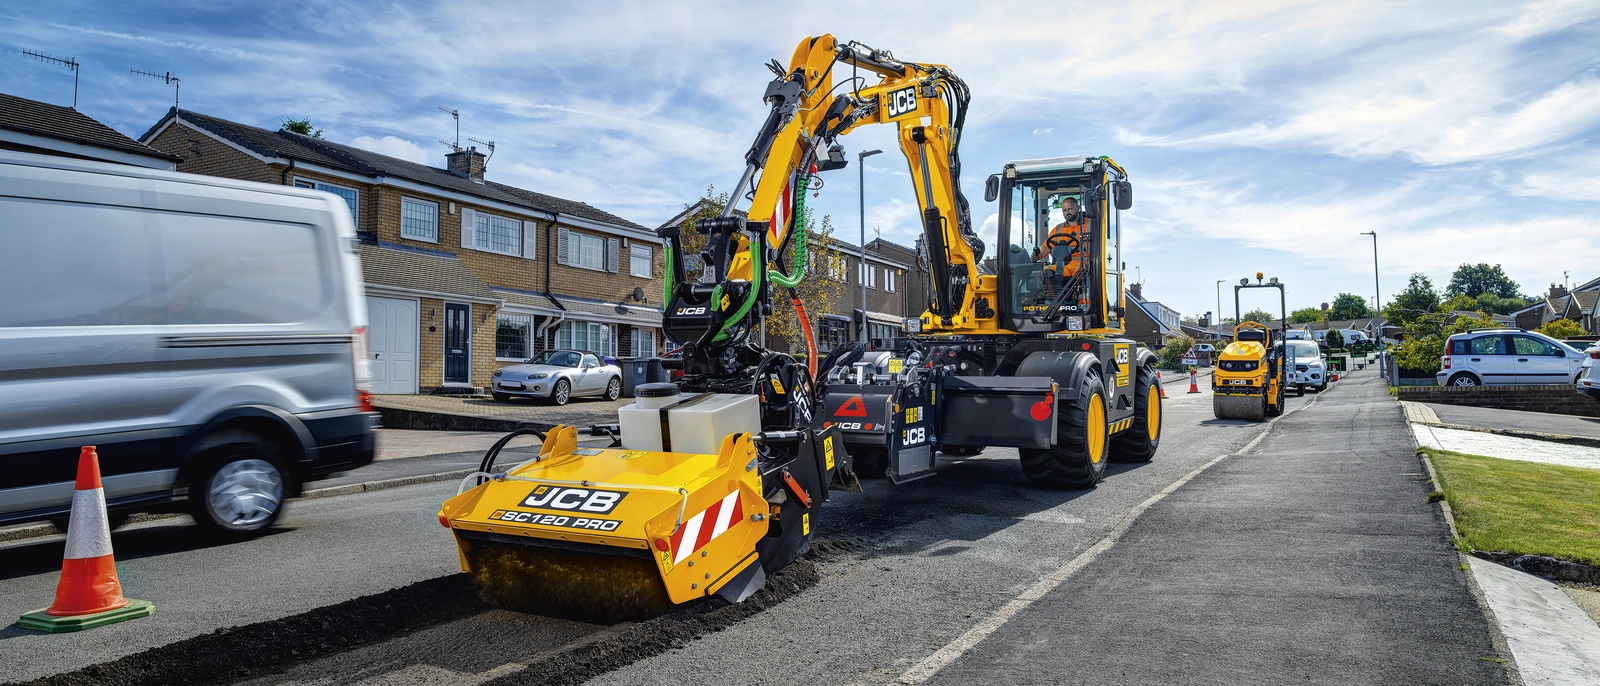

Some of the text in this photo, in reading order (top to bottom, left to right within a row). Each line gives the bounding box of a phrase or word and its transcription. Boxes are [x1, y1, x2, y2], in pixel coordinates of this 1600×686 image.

[889, 88, 917, 116] JCB
[676, 307, 706, 316] JCB
[902, 427, 926, 446] JCB
[524, 487, 621, 512] JCB
[500, 511, 570, 526] SC120
[571, 518, 620, 531] PRO
